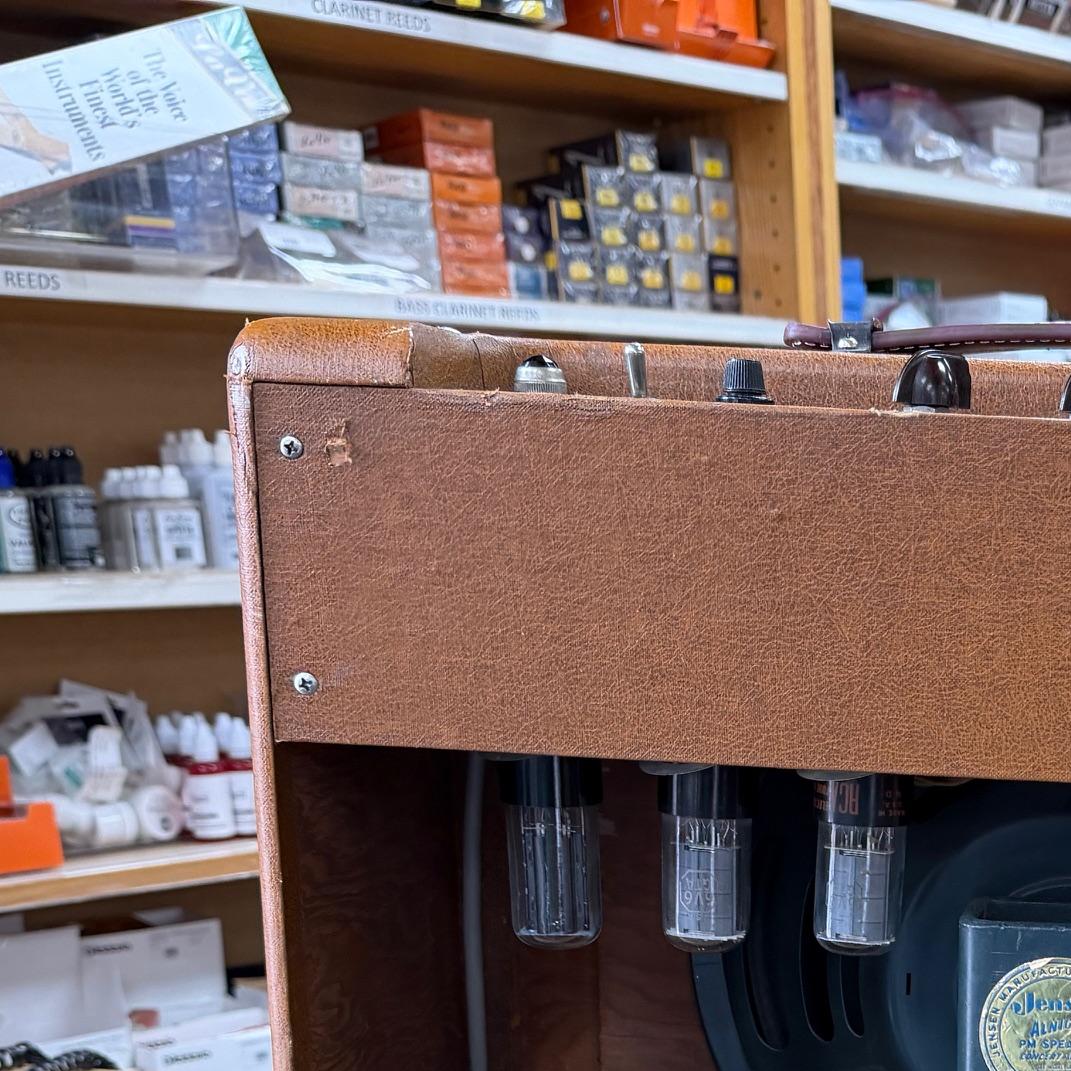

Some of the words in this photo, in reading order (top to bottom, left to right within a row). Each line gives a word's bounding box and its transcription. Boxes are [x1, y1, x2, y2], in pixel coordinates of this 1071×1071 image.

[311, 0, 383, 26] CLARINET
[386, 12, 432, 33] REEDS
[79, 78, 121, 130] Finest
[100, 66, 142, 130] World's
[136, 85, 160, 115] the
[142, 47, 167, 80] The
[159, 80, 188, 123] Voice
[42, 60, 106, 163] Instruments
[4, 270, 61, 291] REEDS
[988, 1007, 1001, 1057] JENSEN
[1019, 1039, 1037, 1050] PM
[1019, 1052, 1063, 1062] CONCERT
